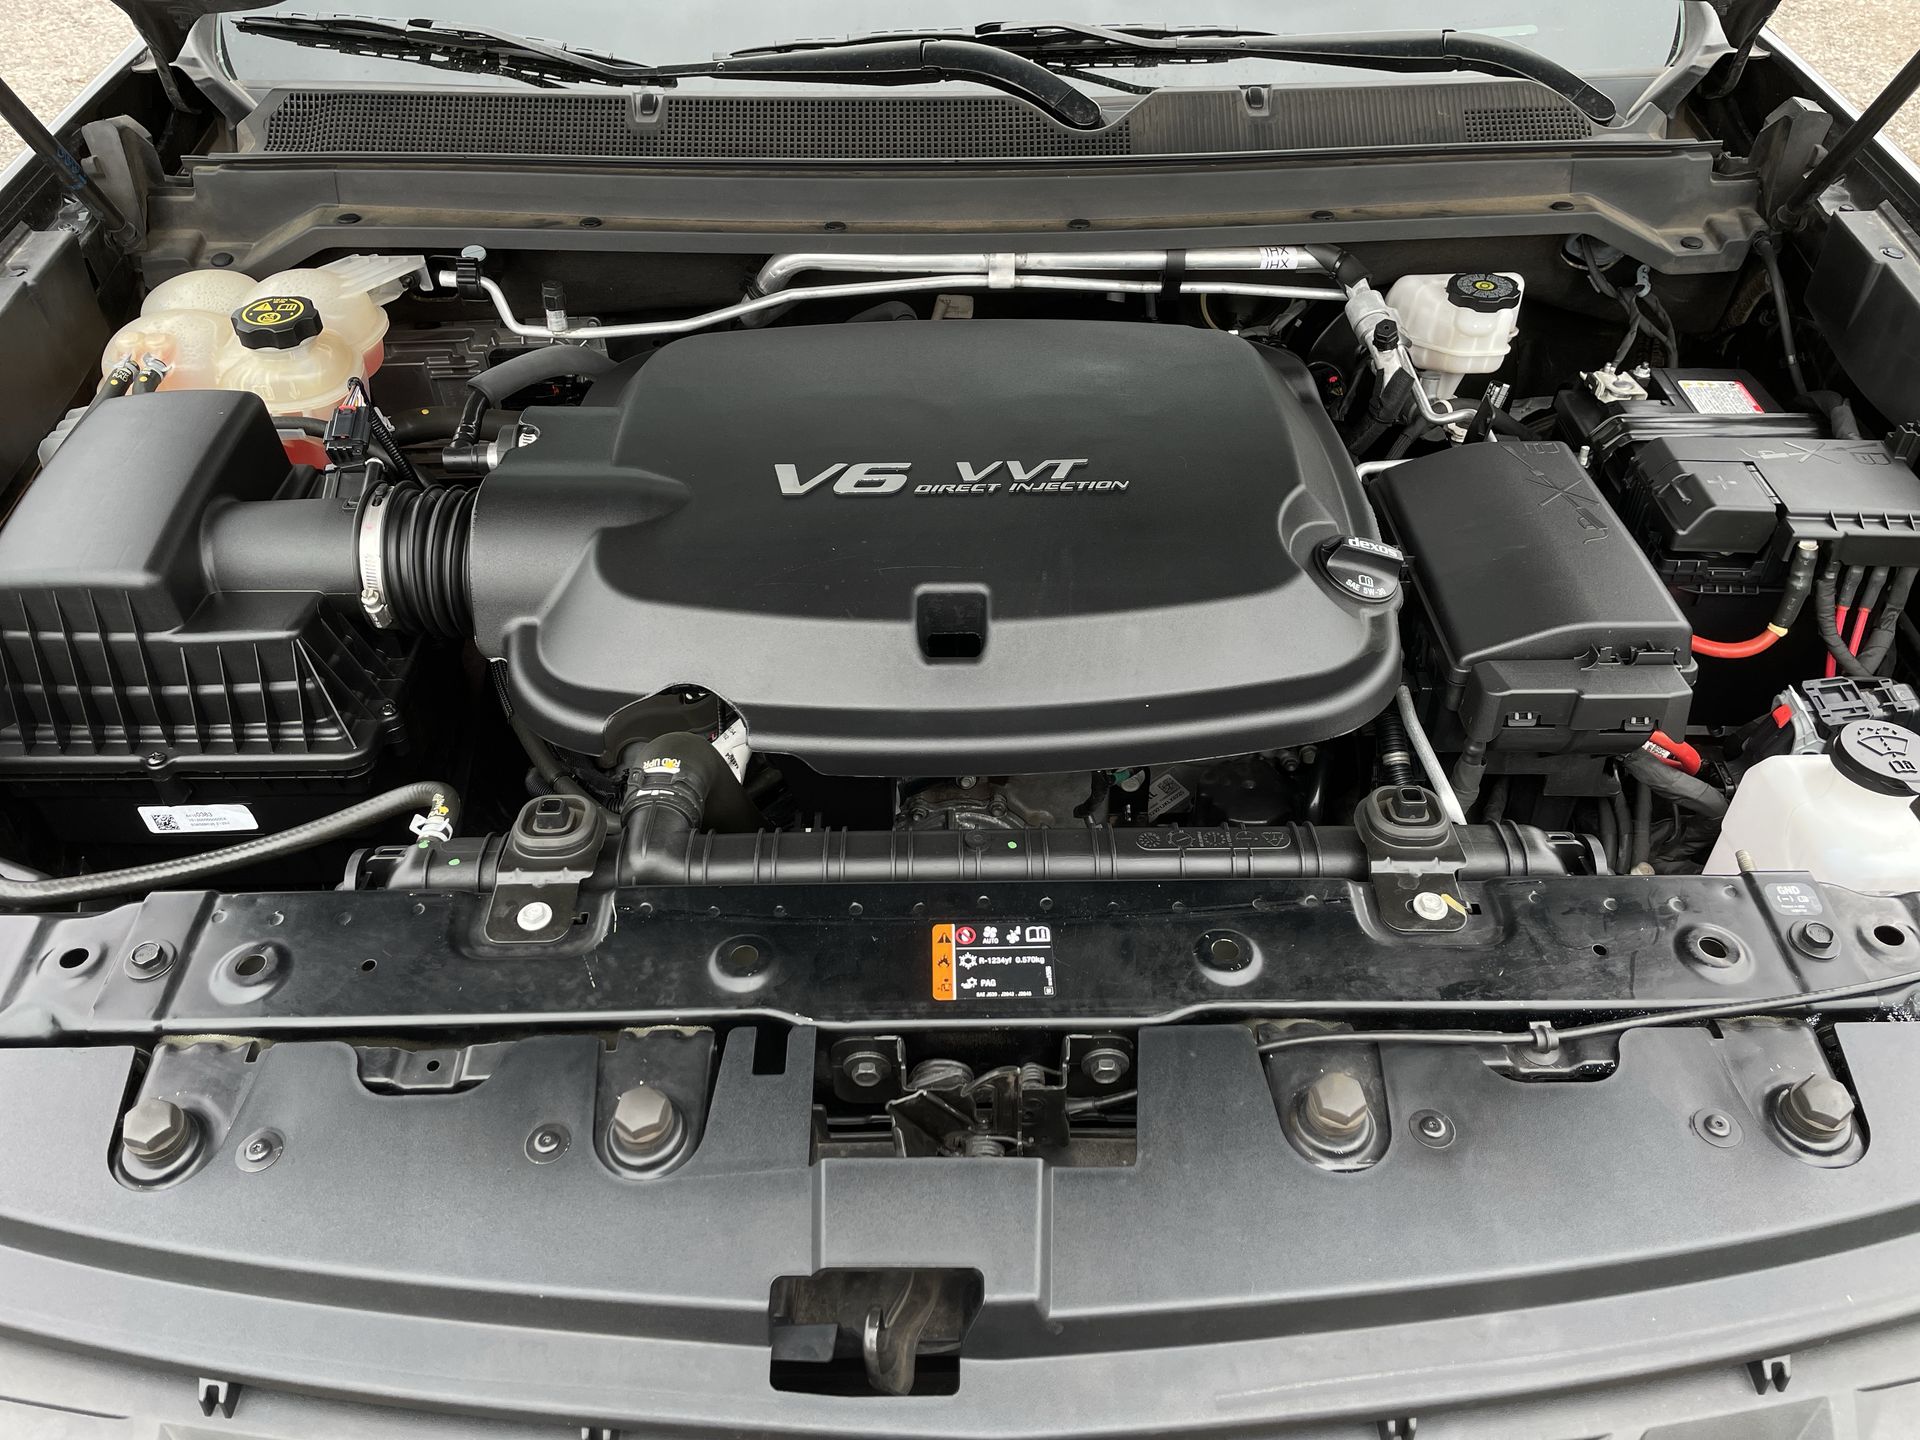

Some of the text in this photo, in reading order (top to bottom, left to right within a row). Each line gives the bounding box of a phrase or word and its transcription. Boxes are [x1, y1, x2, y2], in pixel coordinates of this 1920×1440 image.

[955, 458, 1089, 482] VVT
[774, 462, 912, 496] V6
[913, 480, 1130, 495] DIRECT INJECTION
[1348, 537, 1398, 558] dexos
[1345, 579, 1360, 591] SAE
[643, 758, 661, 768] UPR
[1776, 886, 1800, 895] GND
[978, 956, 1045, 965] R-1234yf 0.570kg
[980, 979, 997, 987] PAG
